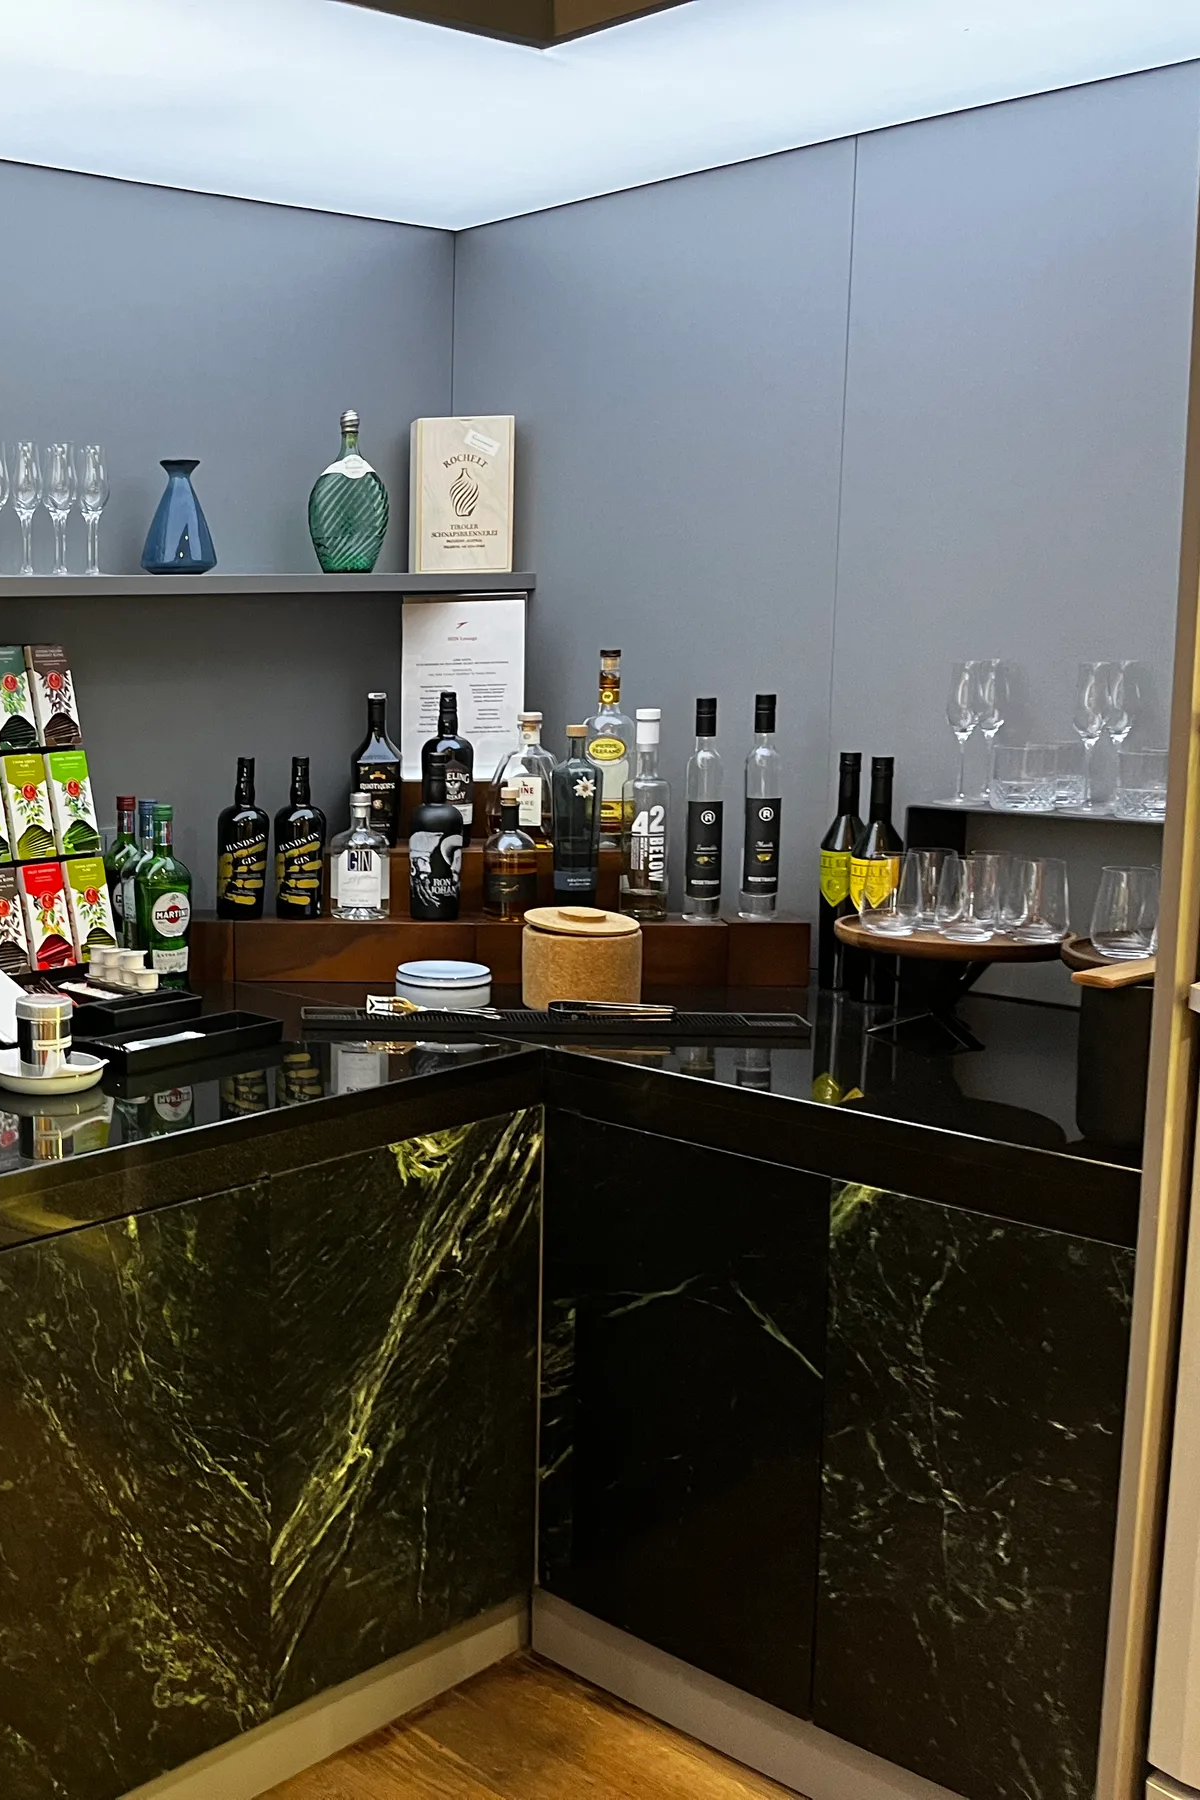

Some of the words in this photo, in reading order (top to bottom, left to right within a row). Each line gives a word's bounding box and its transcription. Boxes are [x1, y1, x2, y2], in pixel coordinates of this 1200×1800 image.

[442, 454, 489, 468] ROCHELT
[446, 772, 470, 784] ELING
[519, 787, 534, 795] INE
[631, 805, 665, 836] 42
[225, 838, 255, 851] HANDS
[279, 838, 307, 851] HANDS
[307, 832, 319, 841] ON
[241, 856, 257, 865] GIN
[294, 856, 310, 865] GIN
[348, 851, 372, 871] GIN
[648, 837, 665, 882] BELOW
[433, 878, 451, 886] RON
